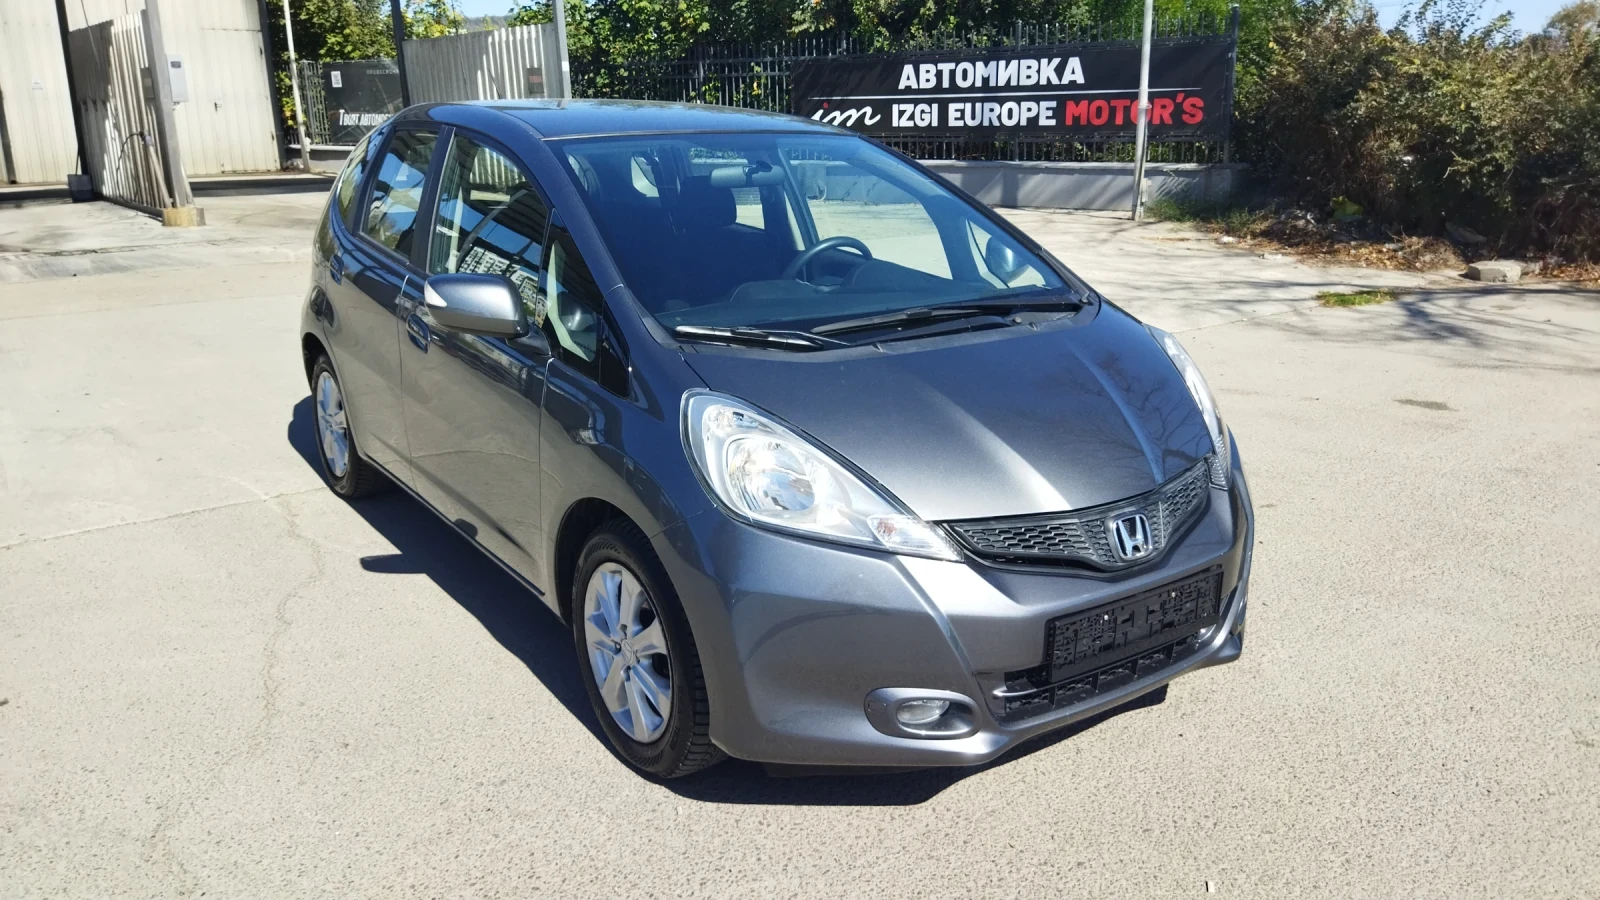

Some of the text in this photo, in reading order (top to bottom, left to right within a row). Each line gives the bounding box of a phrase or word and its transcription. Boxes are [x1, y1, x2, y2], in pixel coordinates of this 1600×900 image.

[898, 56, 1085, 90] АВТОМИВКА
[892, 103, 938, 127] IZGI
[948, 101, 1057, 127] EUROPE
